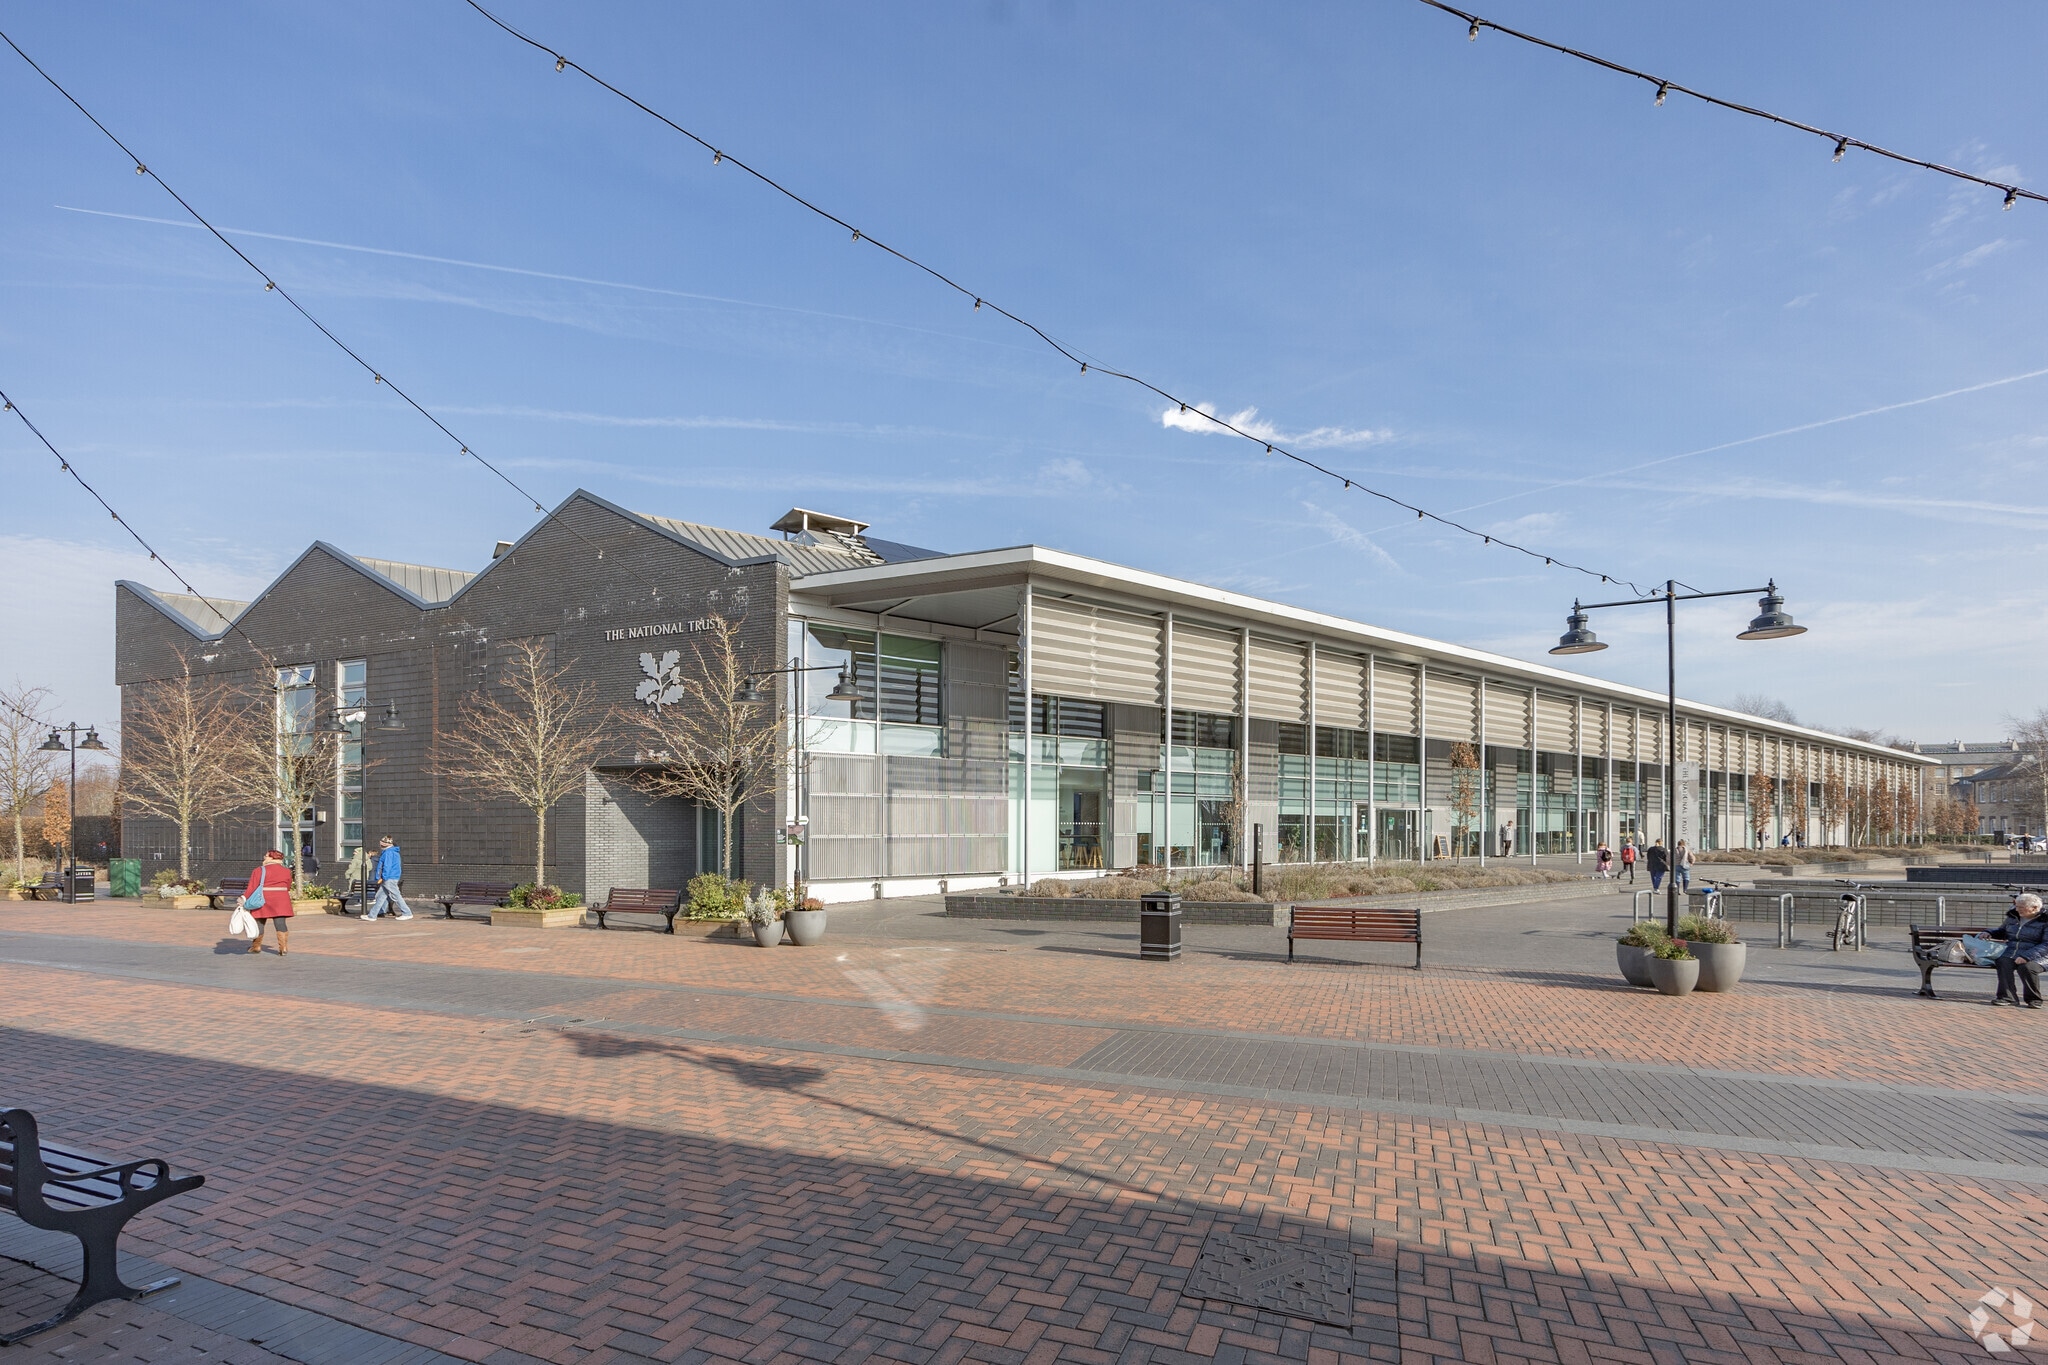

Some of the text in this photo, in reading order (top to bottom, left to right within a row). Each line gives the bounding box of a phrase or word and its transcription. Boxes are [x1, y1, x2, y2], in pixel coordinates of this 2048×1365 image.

[605, 618, 723, 641] THE NATIONAL TRUST
